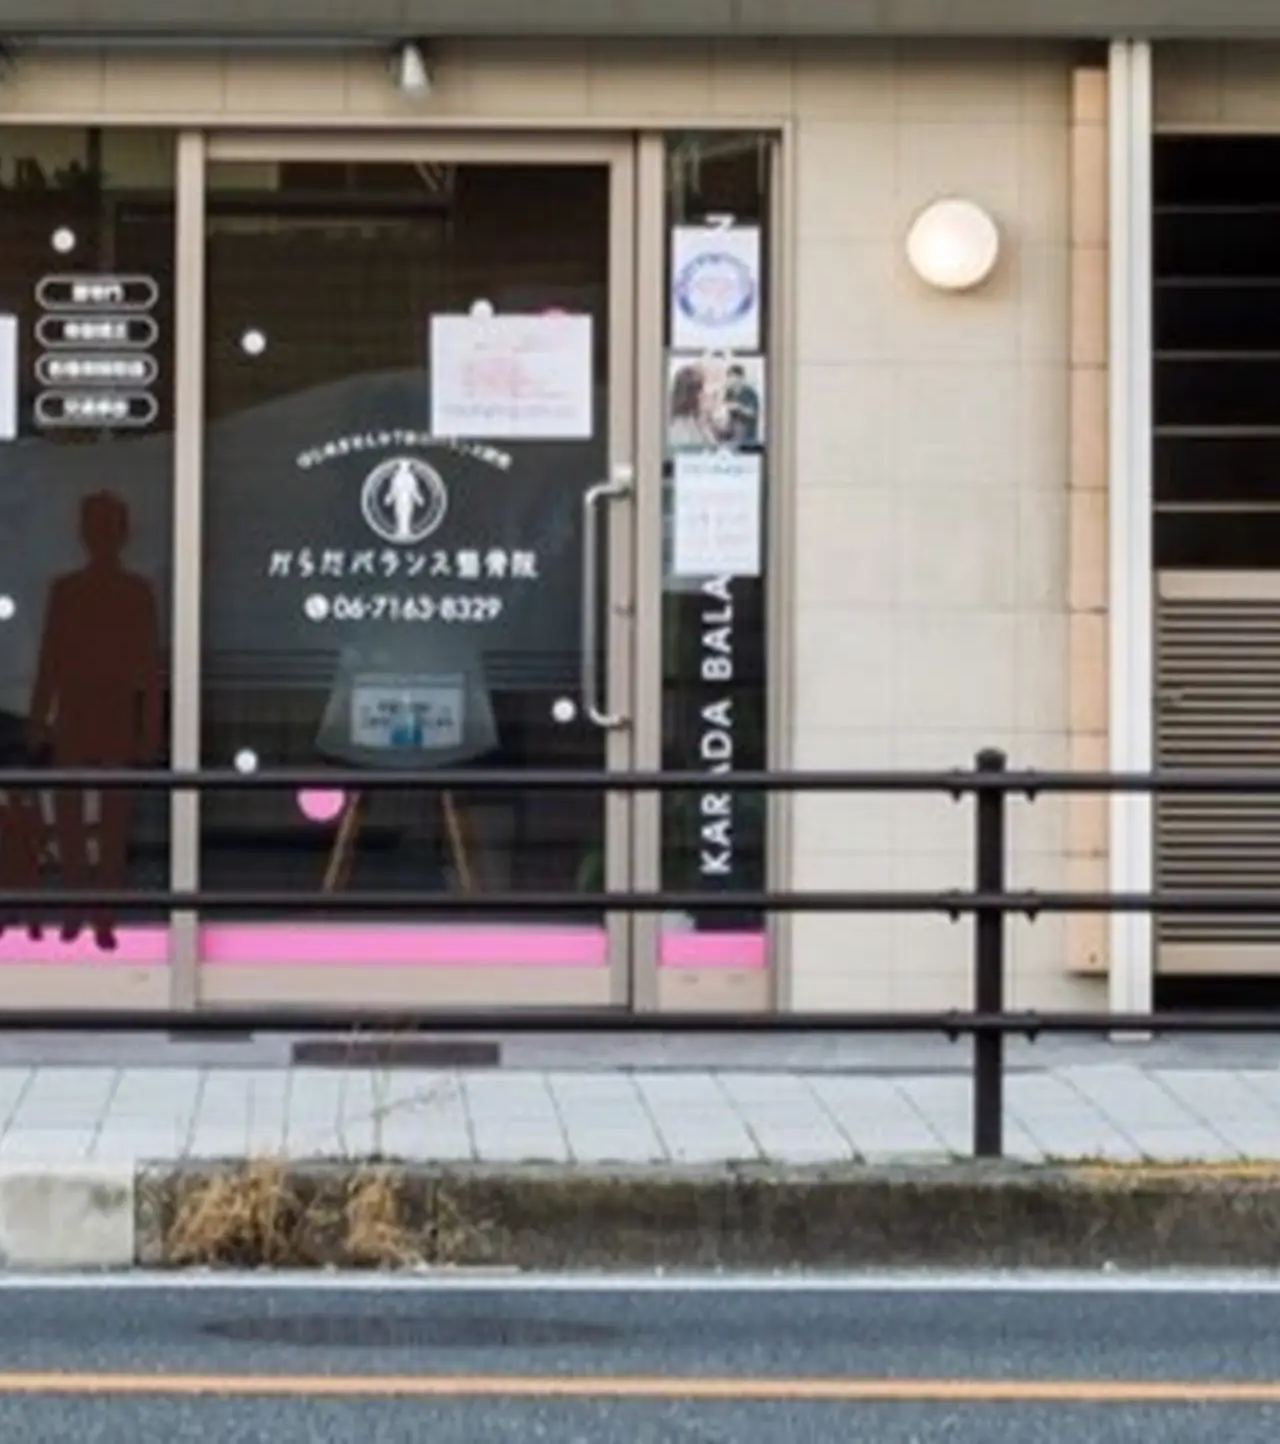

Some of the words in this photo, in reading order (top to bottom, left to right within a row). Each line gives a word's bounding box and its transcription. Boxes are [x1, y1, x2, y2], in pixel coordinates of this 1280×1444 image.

[269, 546, 539, 580] からだバランス整骨院
